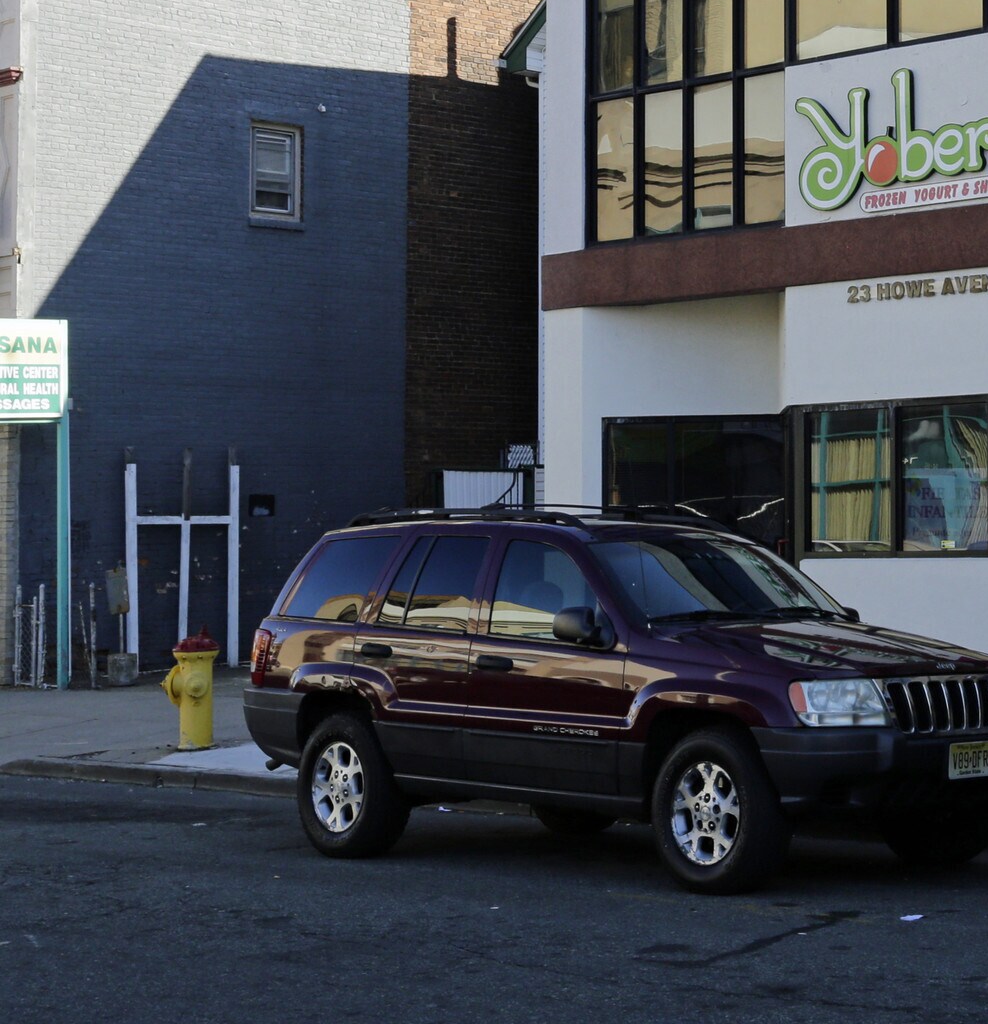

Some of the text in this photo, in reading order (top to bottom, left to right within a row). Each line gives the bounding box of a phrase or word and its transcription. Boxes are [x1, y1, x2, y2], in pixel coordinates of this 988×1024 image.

[864, 191, 907, 209] FROZEN
[914, 183, 957, 203] YOGURT
[962, 180, 970, 196] &
[847, 285, 871, 303] 23
[877, 279, 936, 301] HOWE
[0, 336, 57, 353] SANA
[23, 366, 58, 379] CENTER
[23, 382, 58, 394] HEALTH
[0, 398, 50, 410] SAGES
[533, 725, 599, 737] GRAND CHEROKEE
